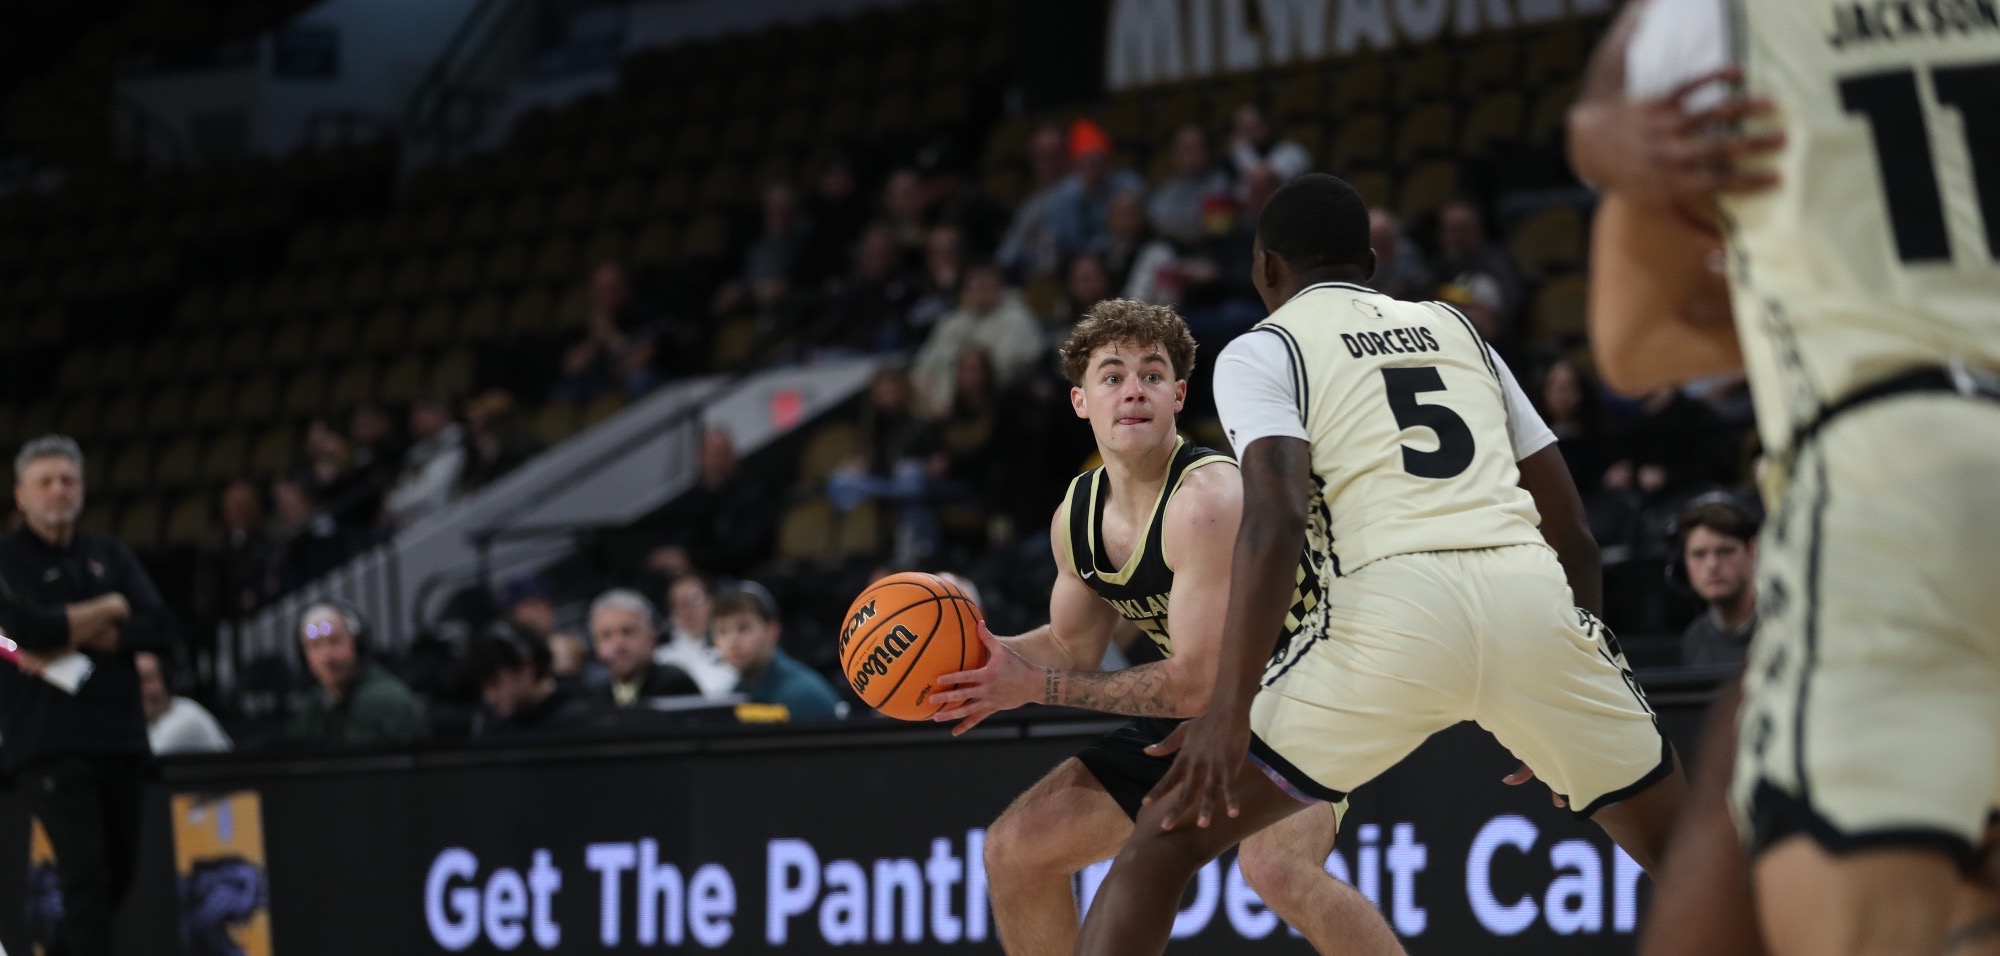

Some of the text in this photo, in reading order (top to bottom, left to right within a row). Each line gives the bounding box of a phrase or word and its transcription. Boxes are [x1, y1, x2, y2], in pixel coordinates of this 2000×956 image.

[1104, 0, 1612, 92] MILWA
[1339, 326, 1441, 359] DORCEUS
[1380, 366, 1476, 479] 5
[1102, 591, 1171, 618] AKLAN
[852, 624, 919, 695] Wilson
[424, 847, 562, 950] Get
[585, 838, 737, 946] The
[766, 828, 1116, 945] Panth
[1466, 813, 1646, 937] Car
